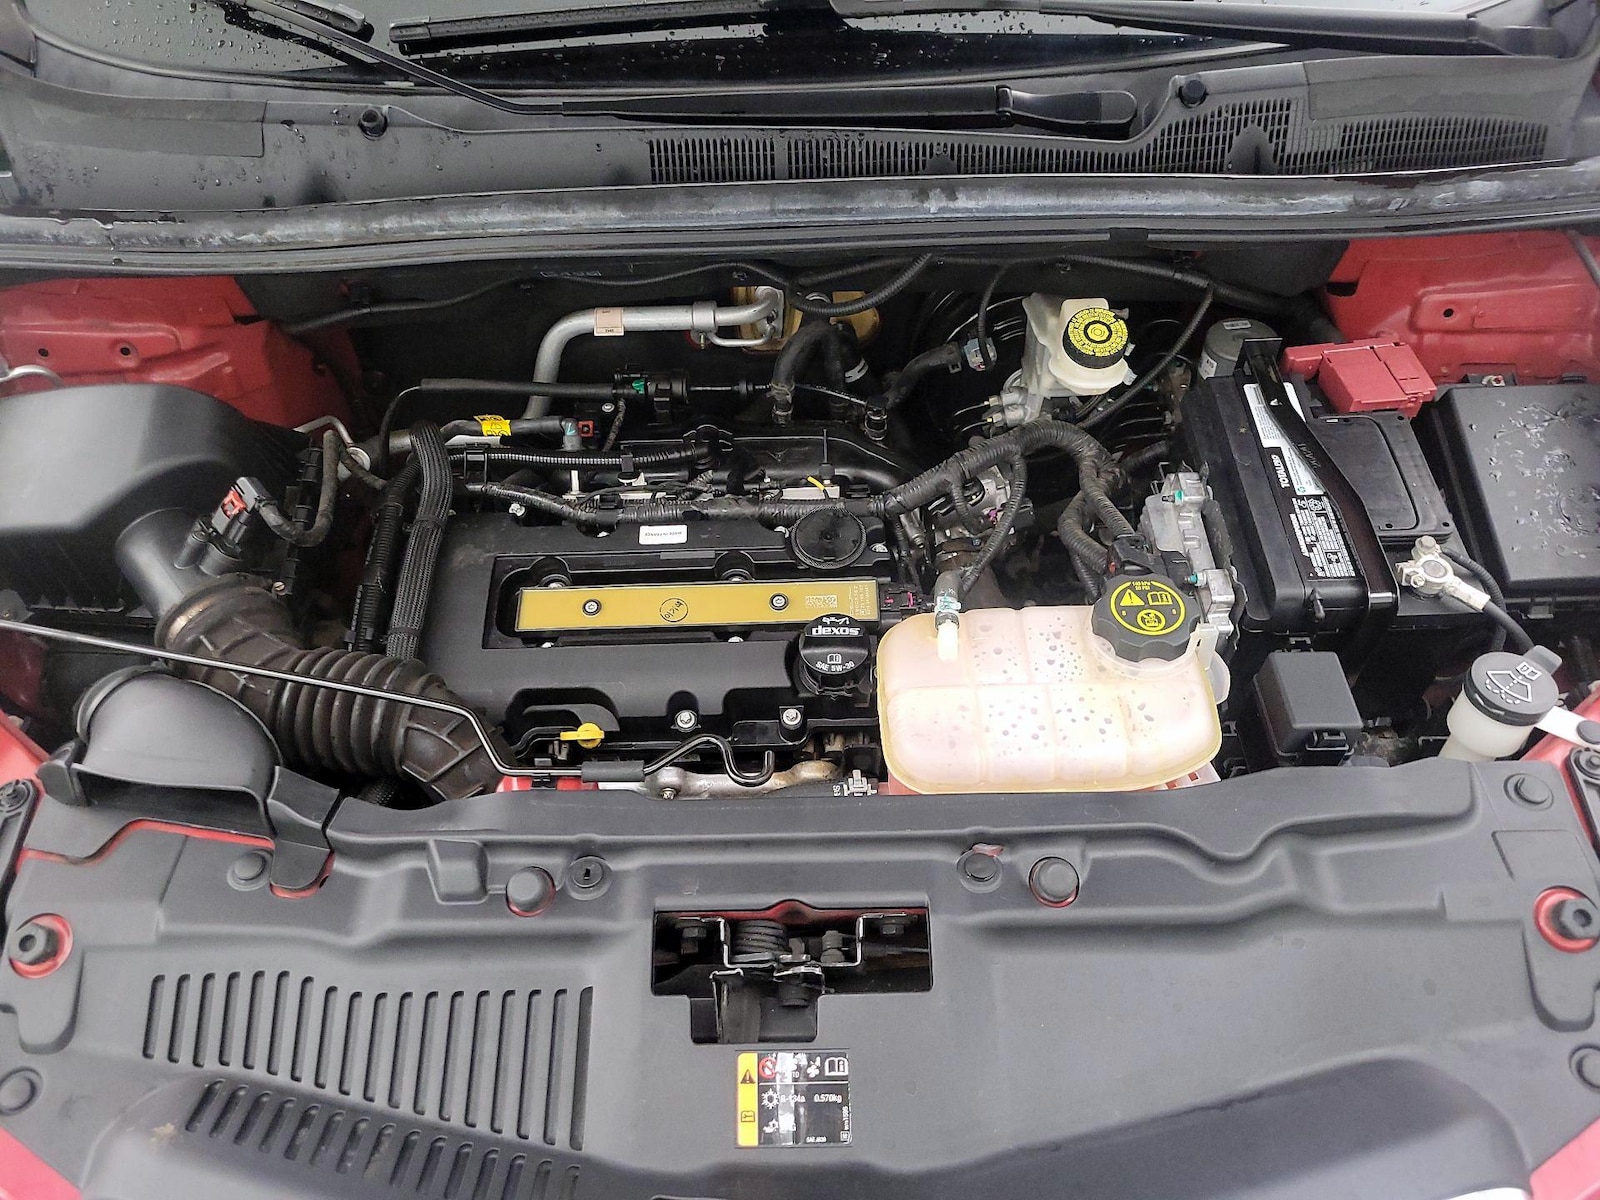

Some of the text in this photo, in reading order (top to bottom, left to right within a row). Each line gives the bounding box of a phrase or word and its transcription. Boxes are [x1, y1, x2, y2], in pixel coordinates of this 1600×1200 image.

[811, 625, 860, 636] dexos
[815, 661, 855, 672] SAE 5W-30
[814, 1093, 842, 1104] 0.570kg
